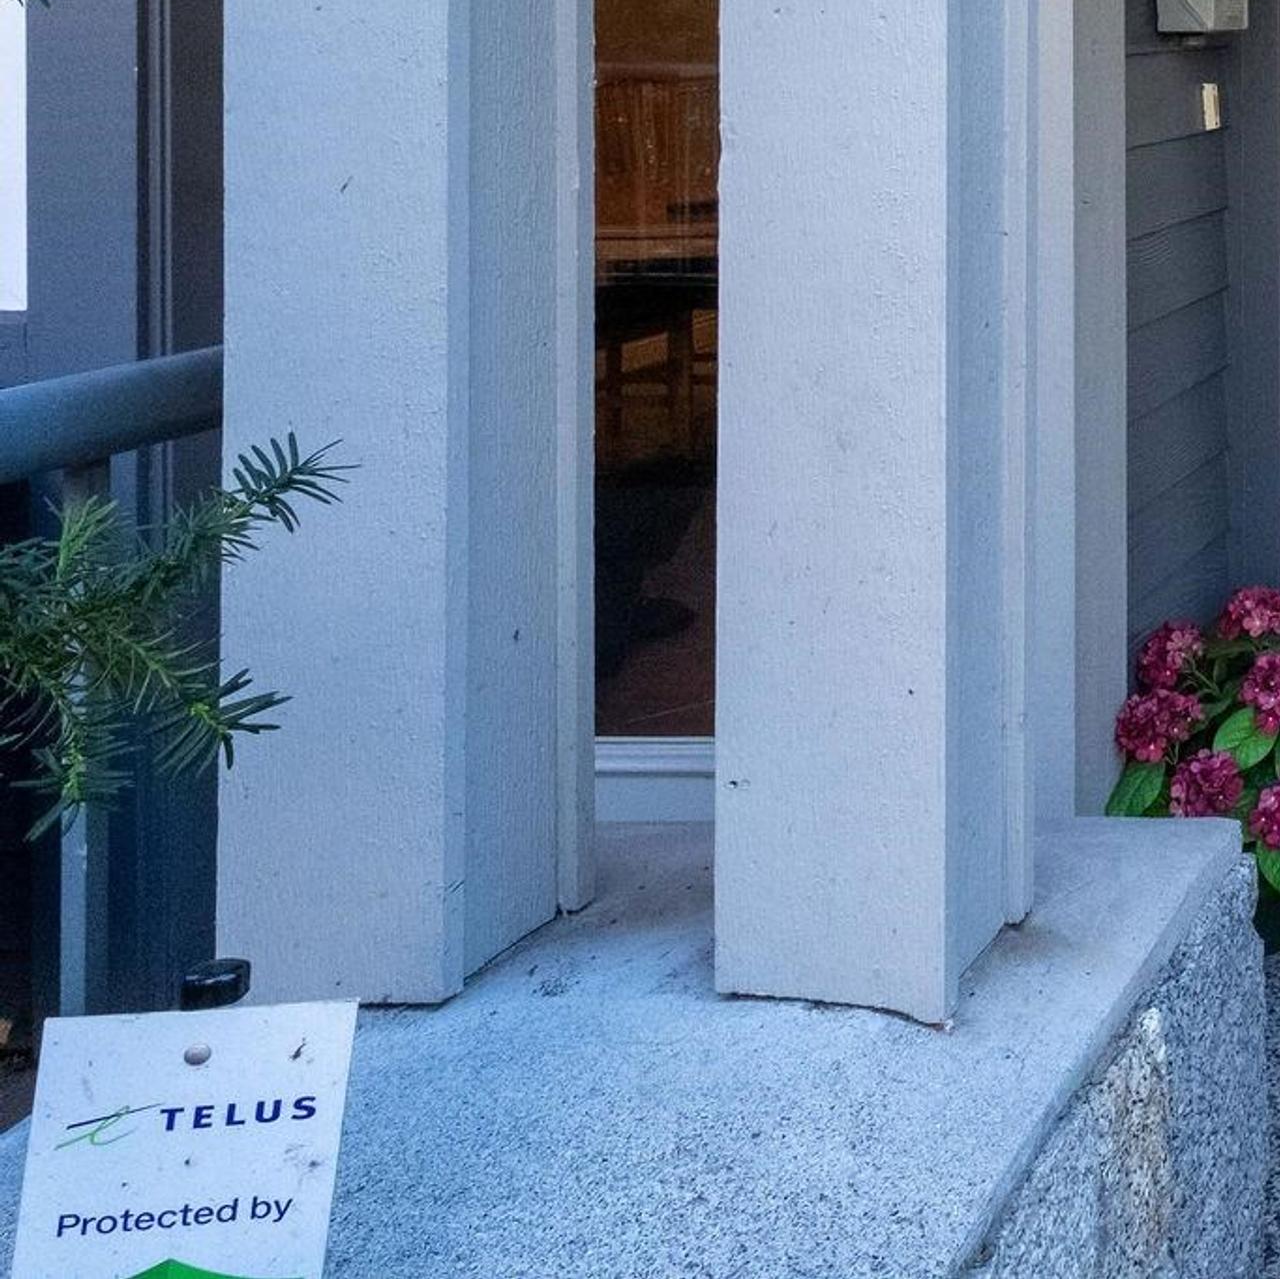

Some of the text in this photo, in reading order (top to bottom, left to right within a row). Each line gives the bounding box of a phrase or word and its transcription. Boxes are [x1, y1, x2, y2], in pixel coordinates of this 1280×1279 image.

[160, 1096, 317, 1131] TELUS
[56, 1195, 293, 1237] Protected by
